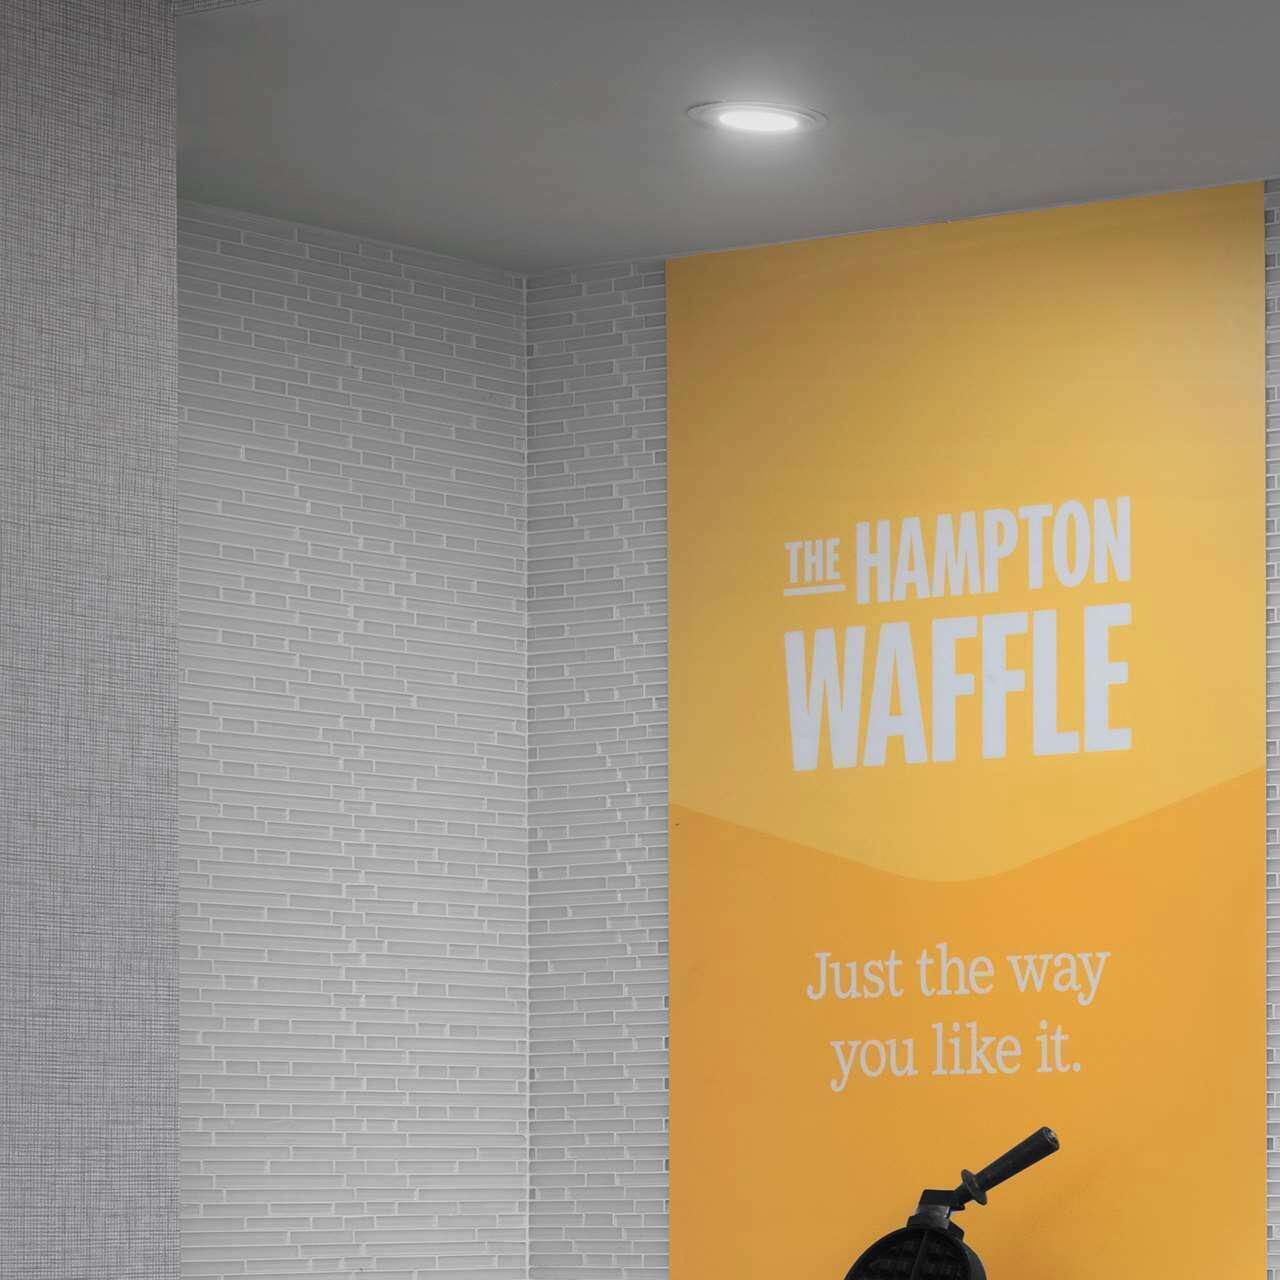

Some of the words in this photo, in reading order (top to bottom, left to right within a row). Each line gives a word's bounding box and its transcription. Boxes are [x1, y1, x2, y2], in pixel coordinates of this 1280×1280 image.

[785, 537, 841, 584] THE
[856, 496, 1132, 605] HAMPTON
[784, 603, 1132, 771] WAFFLE
[806, 948, 903, 1001] Just
[916, 942, 995, 997] the
[1007, 950, 1111, 1006] way
[830, 1037, 918, 1092] you
[931, 1021, 1022, 1075] like
[1035, 1019, 1082, 1074] it.
